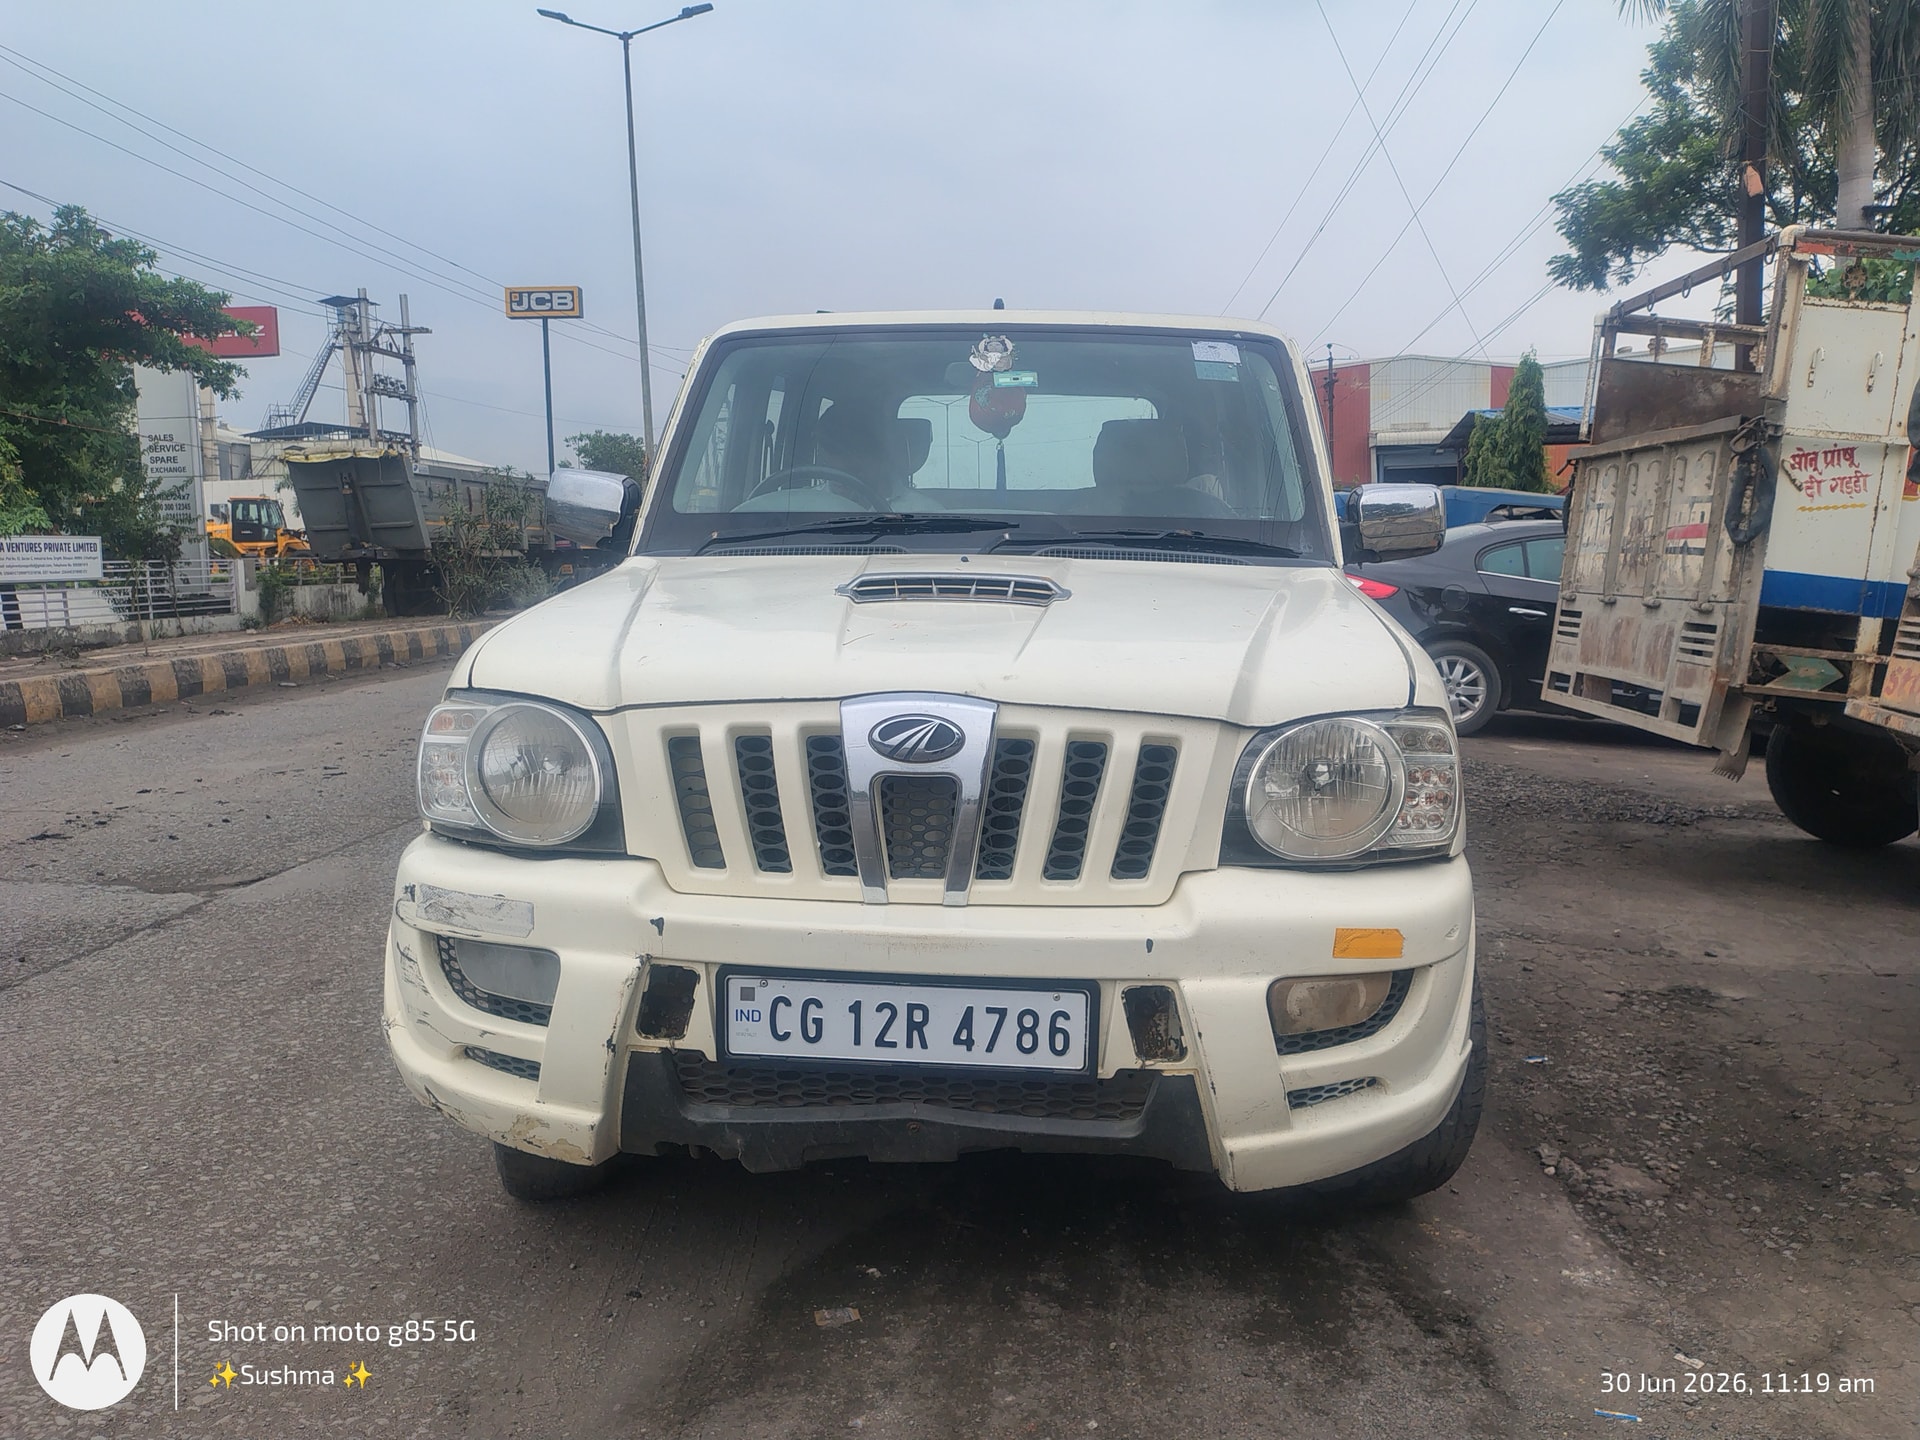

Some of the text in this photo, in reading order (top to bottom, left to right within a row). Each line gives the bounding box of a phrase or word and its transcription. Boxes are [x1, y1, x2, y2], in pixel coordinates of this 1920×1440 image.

[511, 291, 574, 311] JCB
[148, 434, 174, 442] SALES
[149, 444, 187, 453] SERVICE
[149, 455, 179, 465] SPARE
[150, 466, 188, 474] EXCHANGE
[6, 542, 43, 553] VENTURES
[43, 542, 72, 553] PRIVATE
[72, 542, 98, 553] LIMITED
[735, 1008, 762, 1023] IND
[769, 995, 1071, 1057] CG 12R 4786
